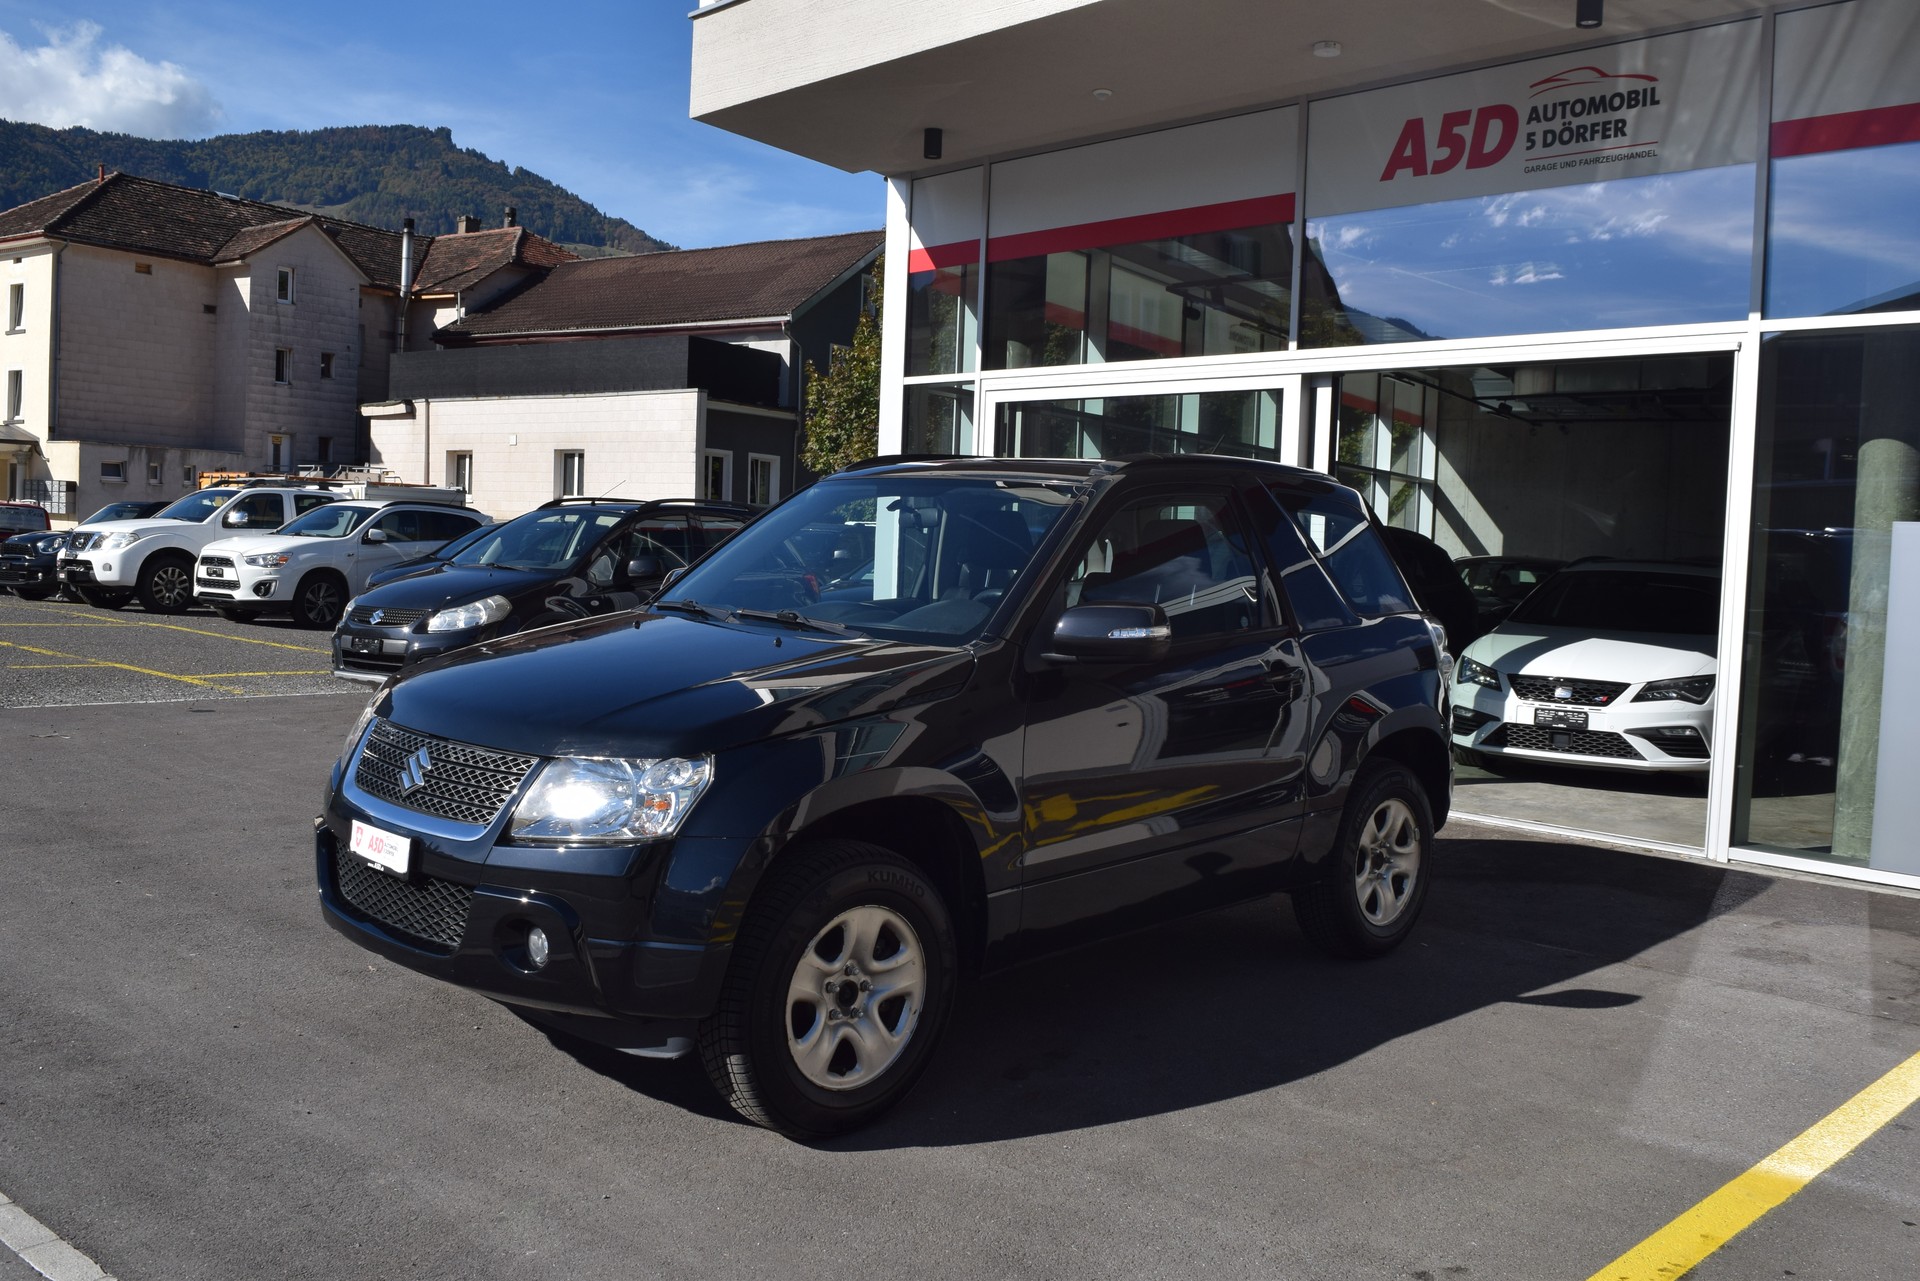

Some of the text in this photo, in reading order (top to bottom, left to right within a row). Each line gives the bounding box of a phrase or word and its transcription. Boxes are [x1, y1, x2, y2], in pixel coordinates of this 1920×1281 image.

[1526, 86, 1660, 125] AUTOMOBIL
[1379, 103, 1520, 182] A5D
[1525, 118, 1628, 151] 5 DÖRFER
[1524, 150, 1658, 174] GARAGE UND FAHRZEUGHANDEL
[867, 870, 925, 897] KUMHO
